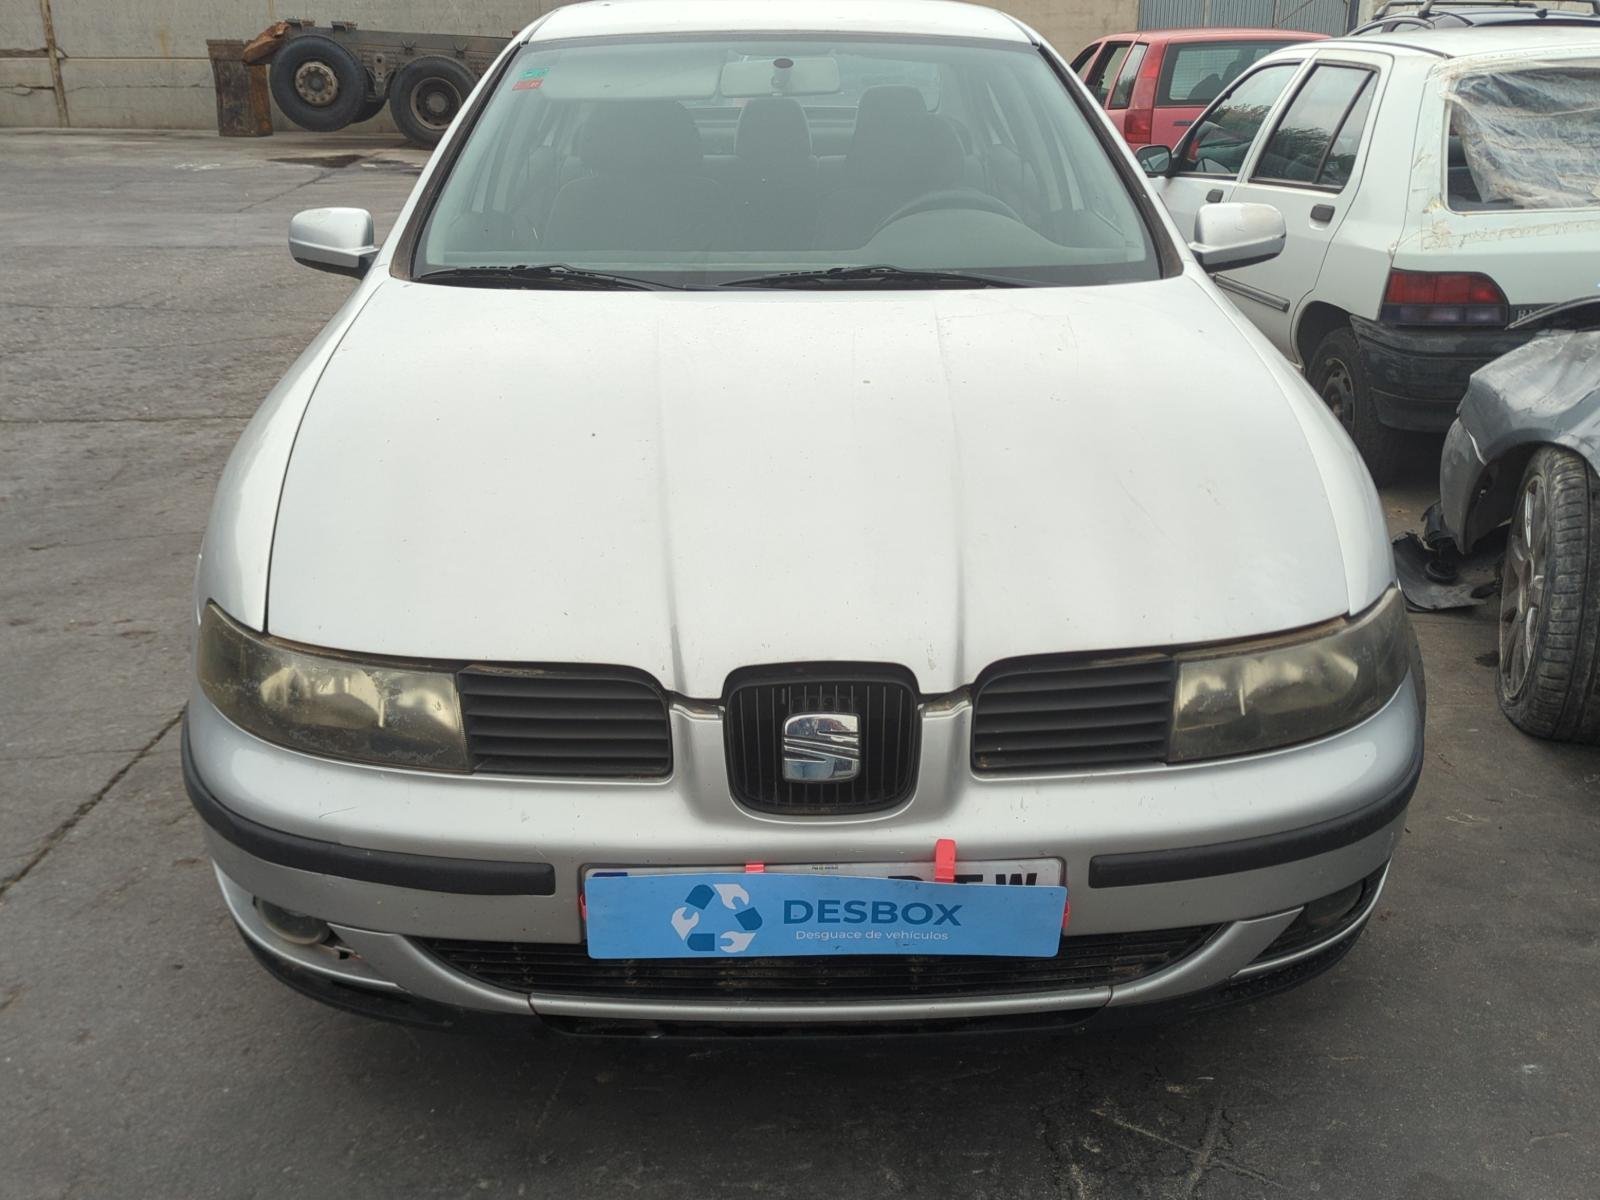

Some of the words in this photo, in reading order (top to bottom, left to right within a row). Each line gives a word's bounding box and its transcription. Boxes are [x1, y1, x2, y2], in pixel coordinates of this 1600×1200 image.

[783, 899, 963, 926] DESBOX
[796, 930, 862, 942] Desguace
[865, 930, 881, 941] de
[885, 930, 949, 941] vehículos
